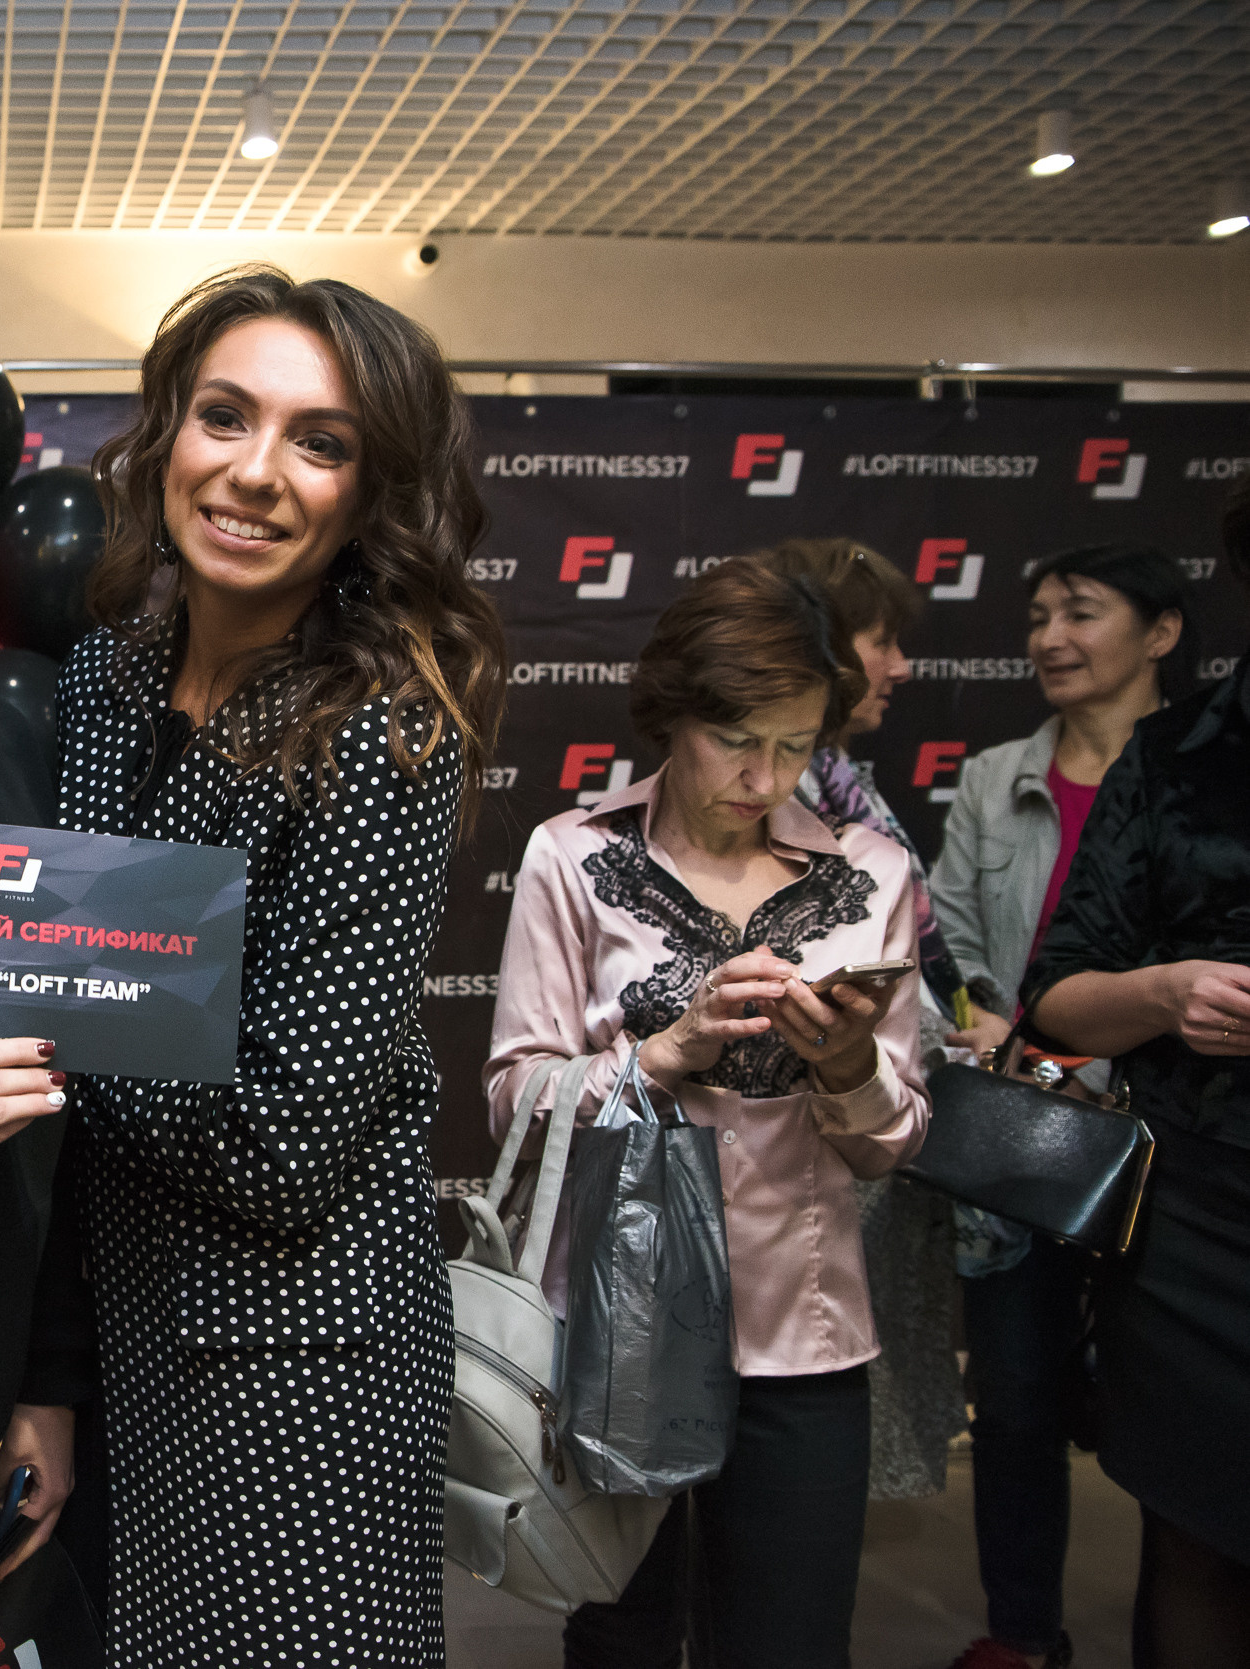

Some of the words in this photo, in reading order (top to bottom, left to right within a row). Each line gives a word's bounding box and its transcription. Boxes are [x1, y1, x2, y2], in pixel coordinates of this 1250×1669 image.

[483, 455, 690, 478] #LOFTFITNESS37
[843, 455, 1039, 477] #LOFTFITNESS37
[19, 921, 199, 956] СЕРТИФИКАТ
